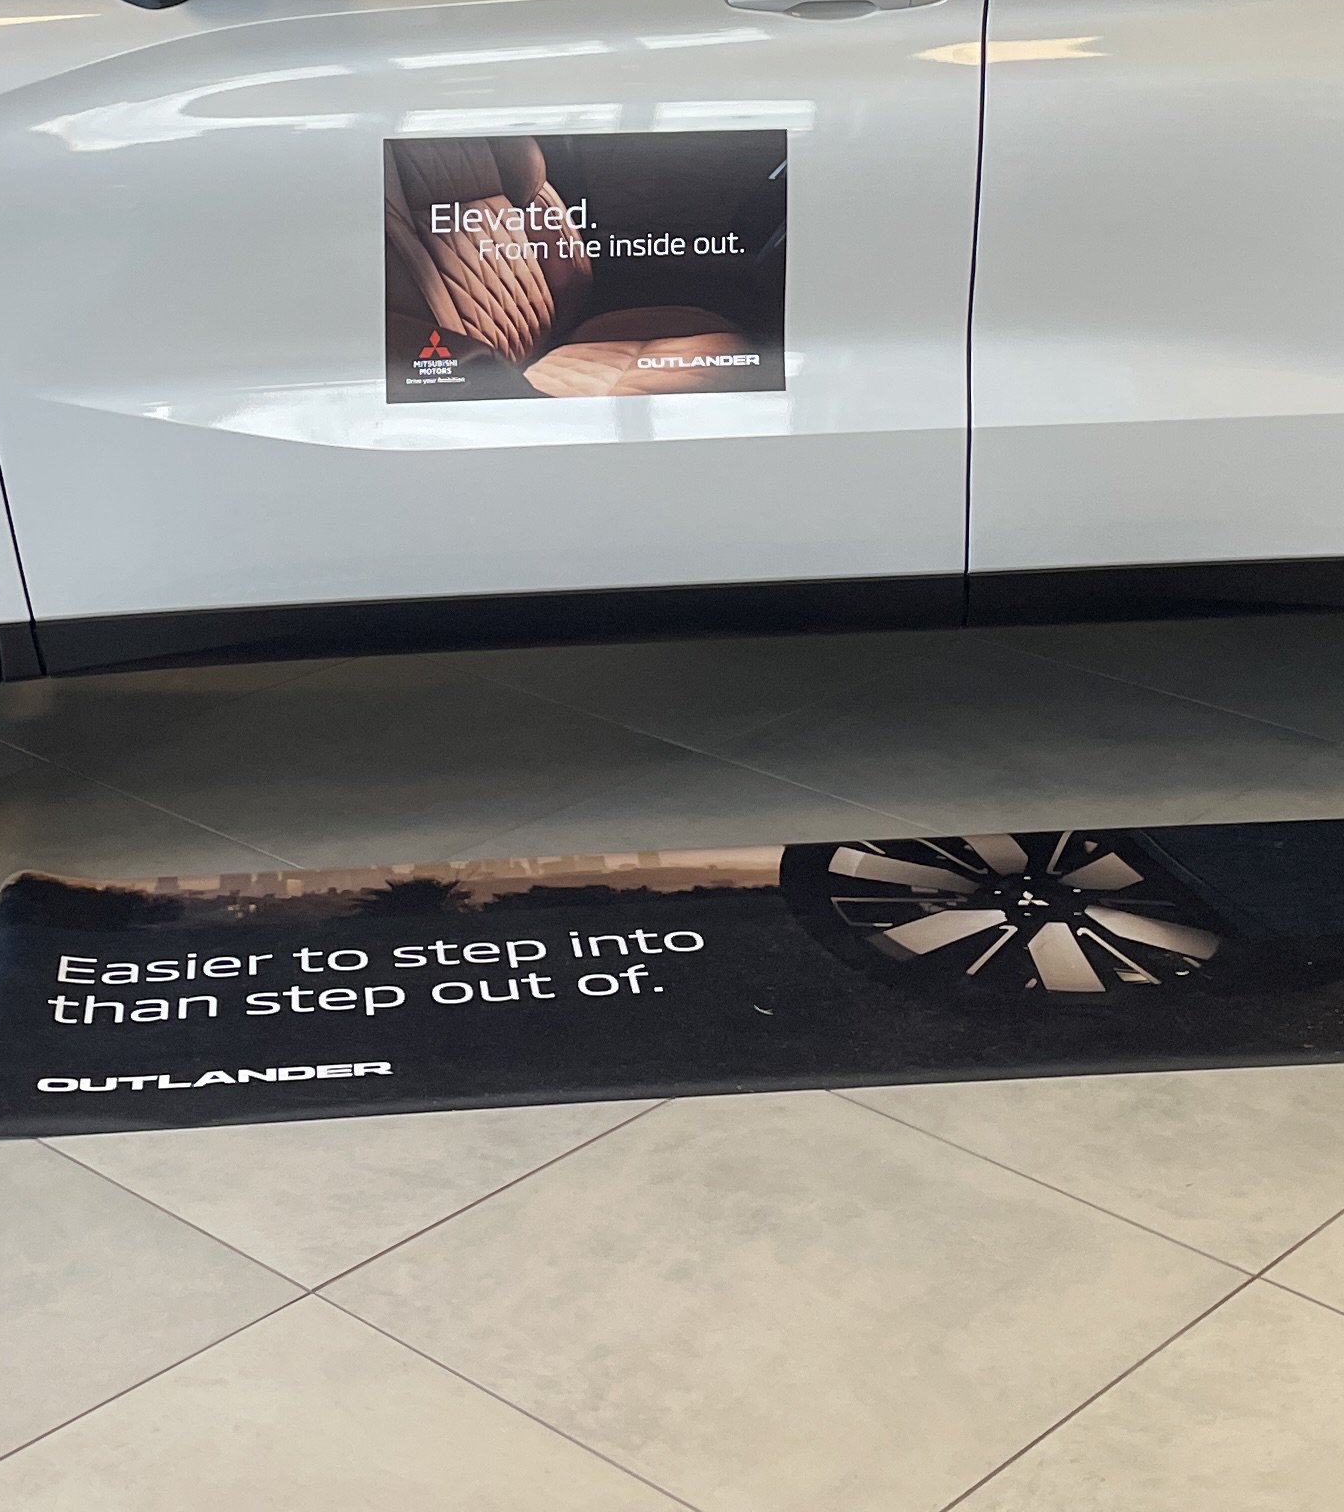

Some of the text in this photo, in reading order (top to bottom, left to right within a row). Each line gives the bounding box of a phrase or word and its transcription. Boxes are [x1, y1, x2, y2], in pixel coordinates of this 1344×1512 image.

[430, 198, 597, 235] Elevated.
[478, 232, 746, 261] From the inside out.
[419, 367, 452, 375] MOTORS
[637, 354, 760, 370] OUTLANDER
[57, 926, 705, 985] Easier to step into
[48, 963, 666, 1026] than step out of.
[37, 1060, 394, 1093] OUTLANDER
